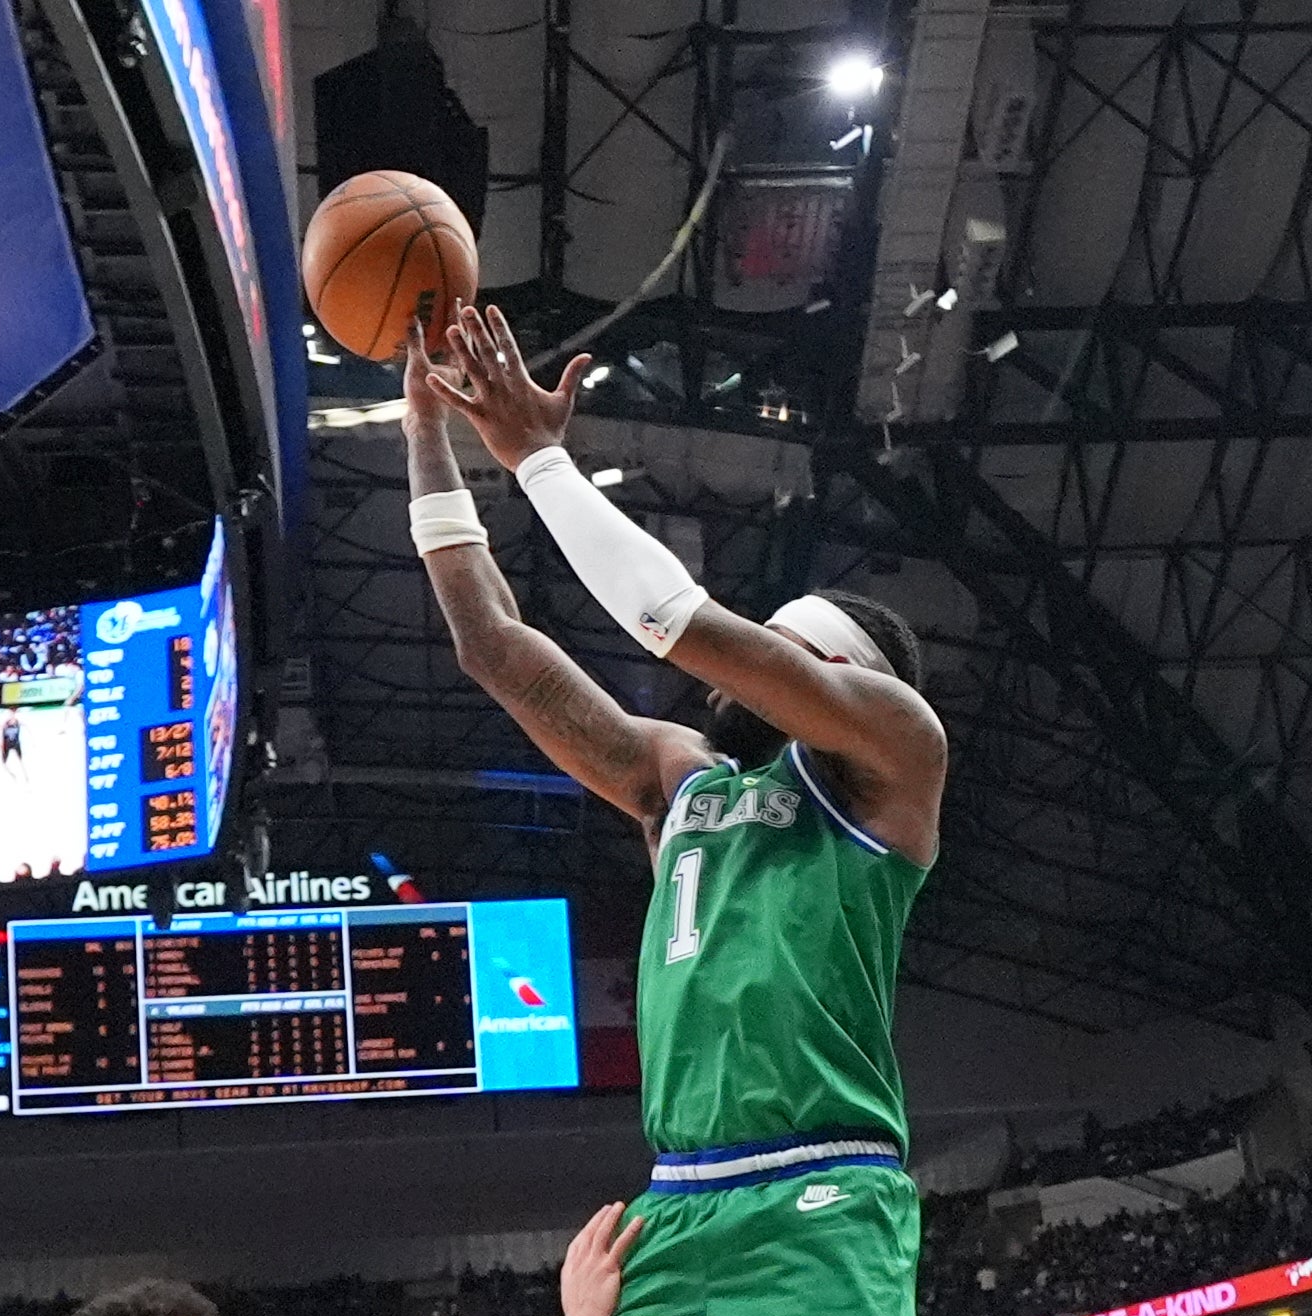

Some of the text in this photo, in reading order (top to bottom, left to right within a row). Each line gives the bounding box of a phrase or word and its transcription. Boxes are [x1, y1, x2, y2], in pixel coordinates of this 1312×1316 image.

[660, 788, 802, 838] LLAS
[72, 871, 371, 912] Amecan Airlines
[665, 847, 703, 966] 1
[479, 1014, 570, 1032] American
[804, 1185, 839, 1201] NIKE
